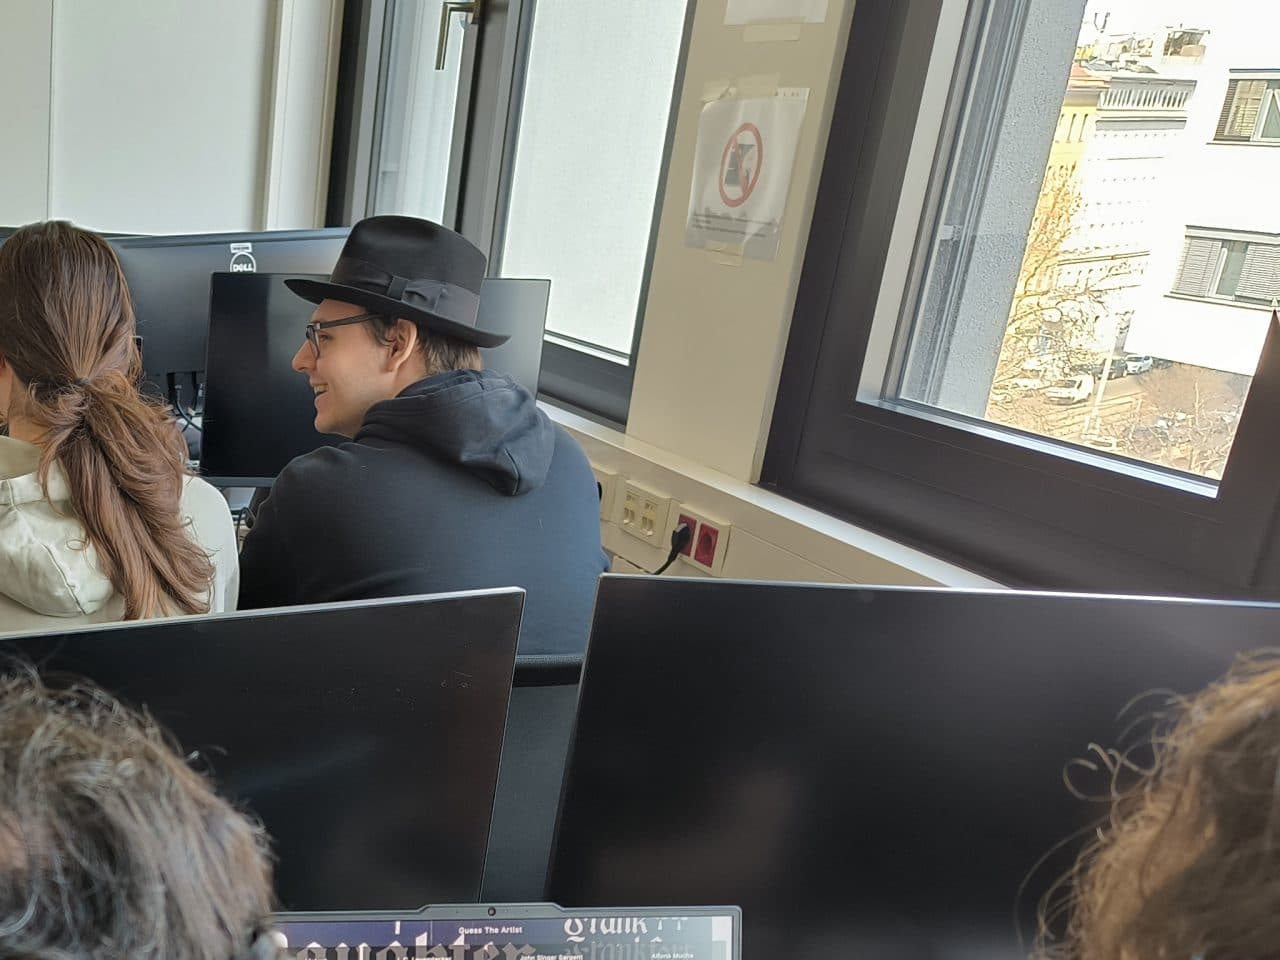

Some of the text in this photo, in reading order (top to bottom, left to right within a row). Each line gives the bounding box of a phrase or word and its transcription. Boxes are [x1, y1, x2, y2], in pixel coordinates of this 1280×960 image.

[232, 263, 254, 272] DELL
[458, 926, 483, 934] Guess
[501, 926, 522, 934] Artist
